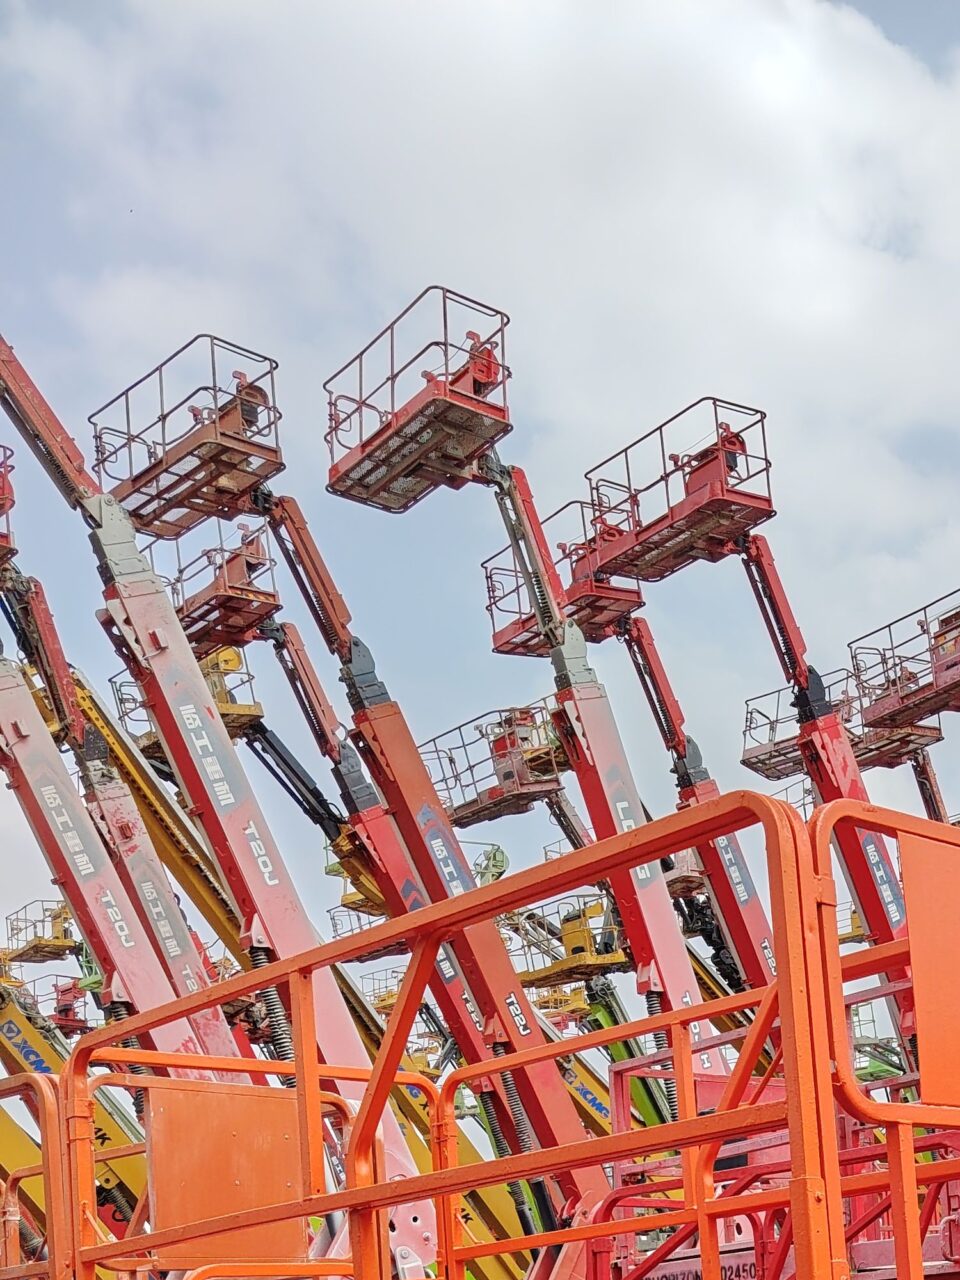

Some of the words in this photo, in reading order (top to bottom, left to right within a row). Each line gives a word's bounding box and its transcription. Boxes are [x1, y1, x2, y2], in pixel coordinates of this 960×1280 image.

[178, 704, 235, 807] 临工重机
[40, 785, 95, 876] 临工重机
[242, 820, 279, 886] T20J
[866, 844, 901, 923] 临工重机
[100, 889, 137, 949] T20J
[140, 881, 183, 959] 临工重机
[461, 990, 485, 1033] T22J
[503, 992, 533, 1038] T22J
[11, 1037, 53, 1074] XCM
[573, 1080, 610, 1119] XCMG
